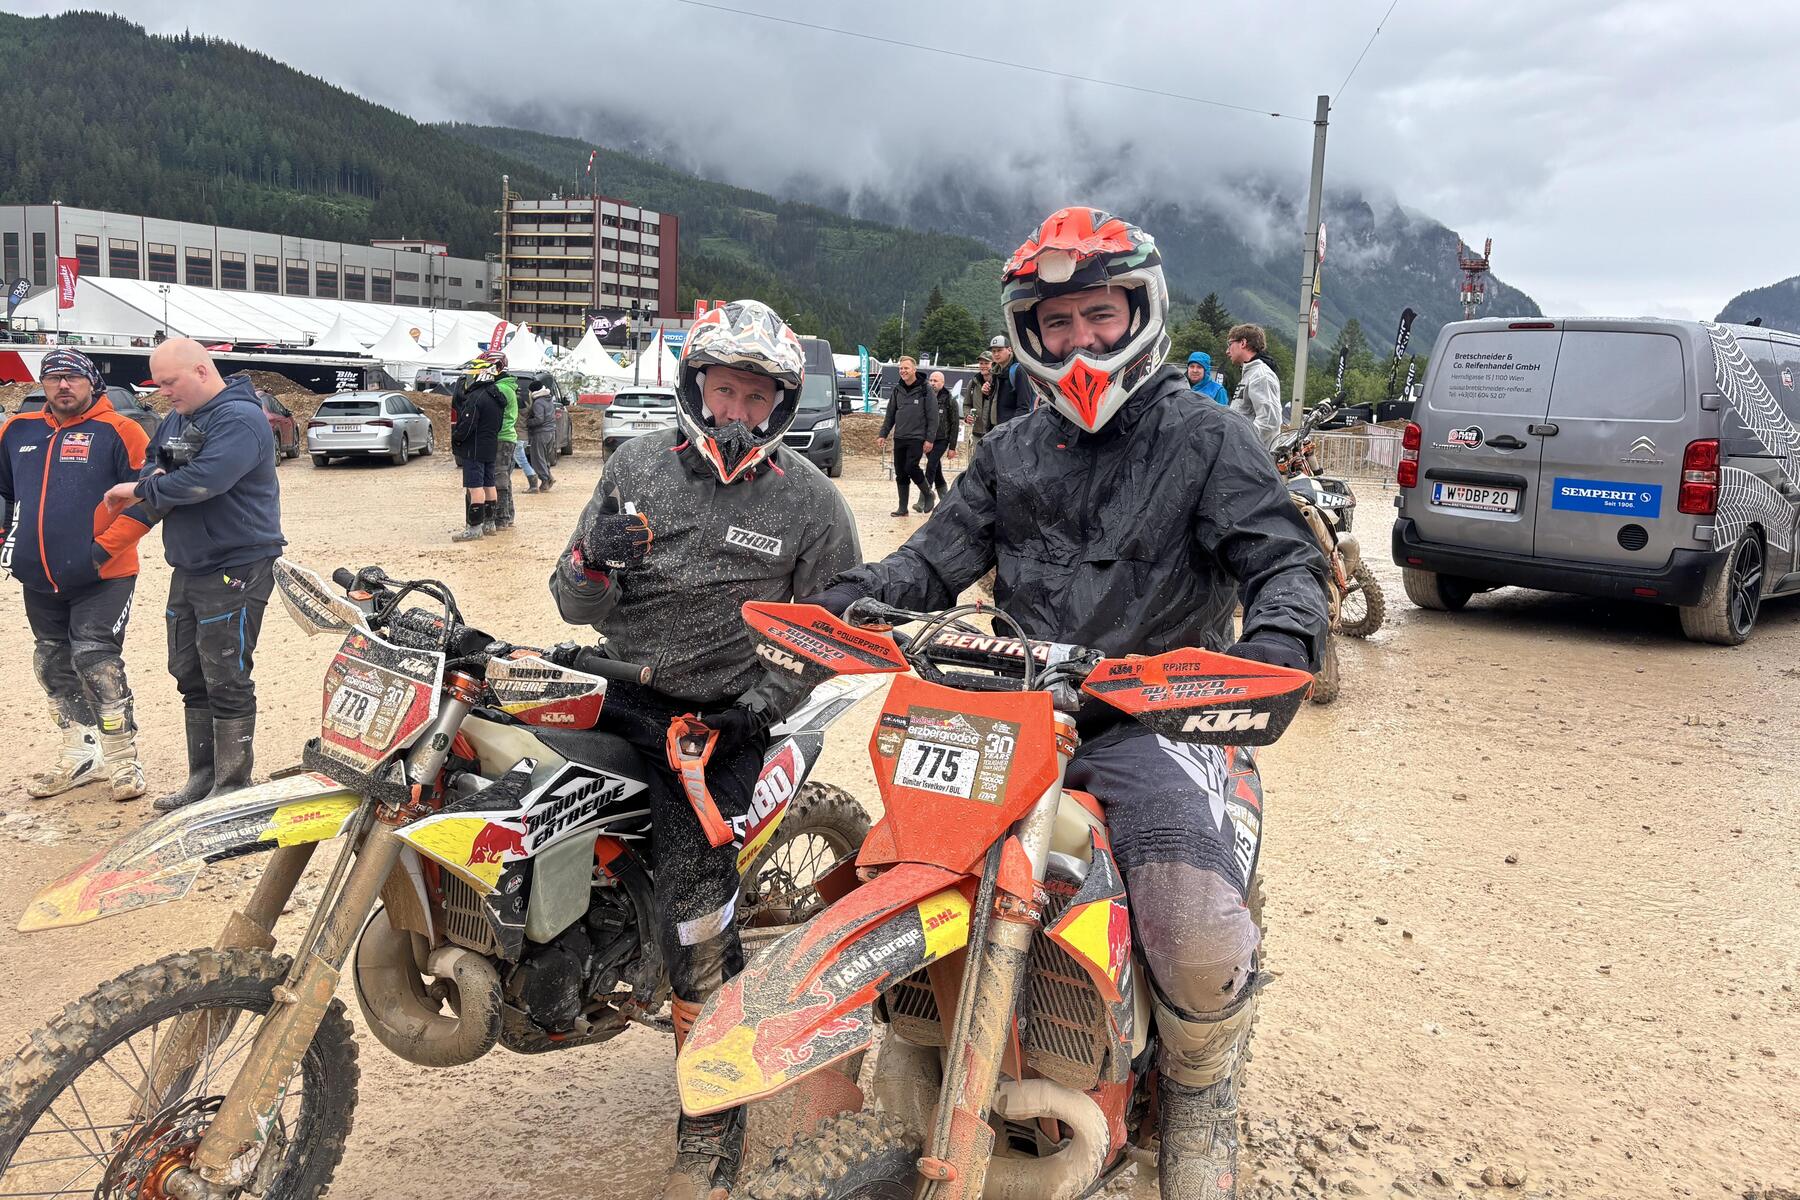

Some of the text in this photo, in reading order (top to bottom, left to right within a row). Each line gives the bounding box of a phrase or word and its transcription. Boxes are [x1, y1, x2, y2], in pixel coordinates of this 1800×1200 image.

[60, 264, 75, 302] Milwaukee
[1465, 362, 1514, 370] Reifenhandel
[1447, 486, 1457, 499] W
[1465, 488, 1489, 503] DBP
[1492, 491, 1509, 505] 20
[1561, 487, 1636, 501] SEMPERIT
[729, 529, 780, 553] THOR
[767, 627, 834, 661] EXTREME
[811, 620, 891, 656] KTM POWERPARTS
[935, 633, 1050, 662] RENTHA
[398, 657, 434, 677] KTM
[756, 643, 805, 675] KTM
[1109, 662, 1201, 676] KTM PRPARTS
[495, 680, 548, 693] EXTREME
[336, 689, 369, 721] 778
[541, 712, 575, 723] KTM
[1181, 708, 1271, 733] KTM
[908, 725, 979, 745] erzbergrodeo
[984, 733, 1015, 754] 30
[913, 744, 963, 782] 775
[984, 752, 1010, 760] YEARS
[902, 777, 922, 786] Dimitar
[949, 786, 961, 795] BUL
[290, 811, 321, 824] DHL
[531, 782, 626, 851] EXTREME
[926, 907, 959, 931] DHL
[868, 928, 922, 964] Garage
